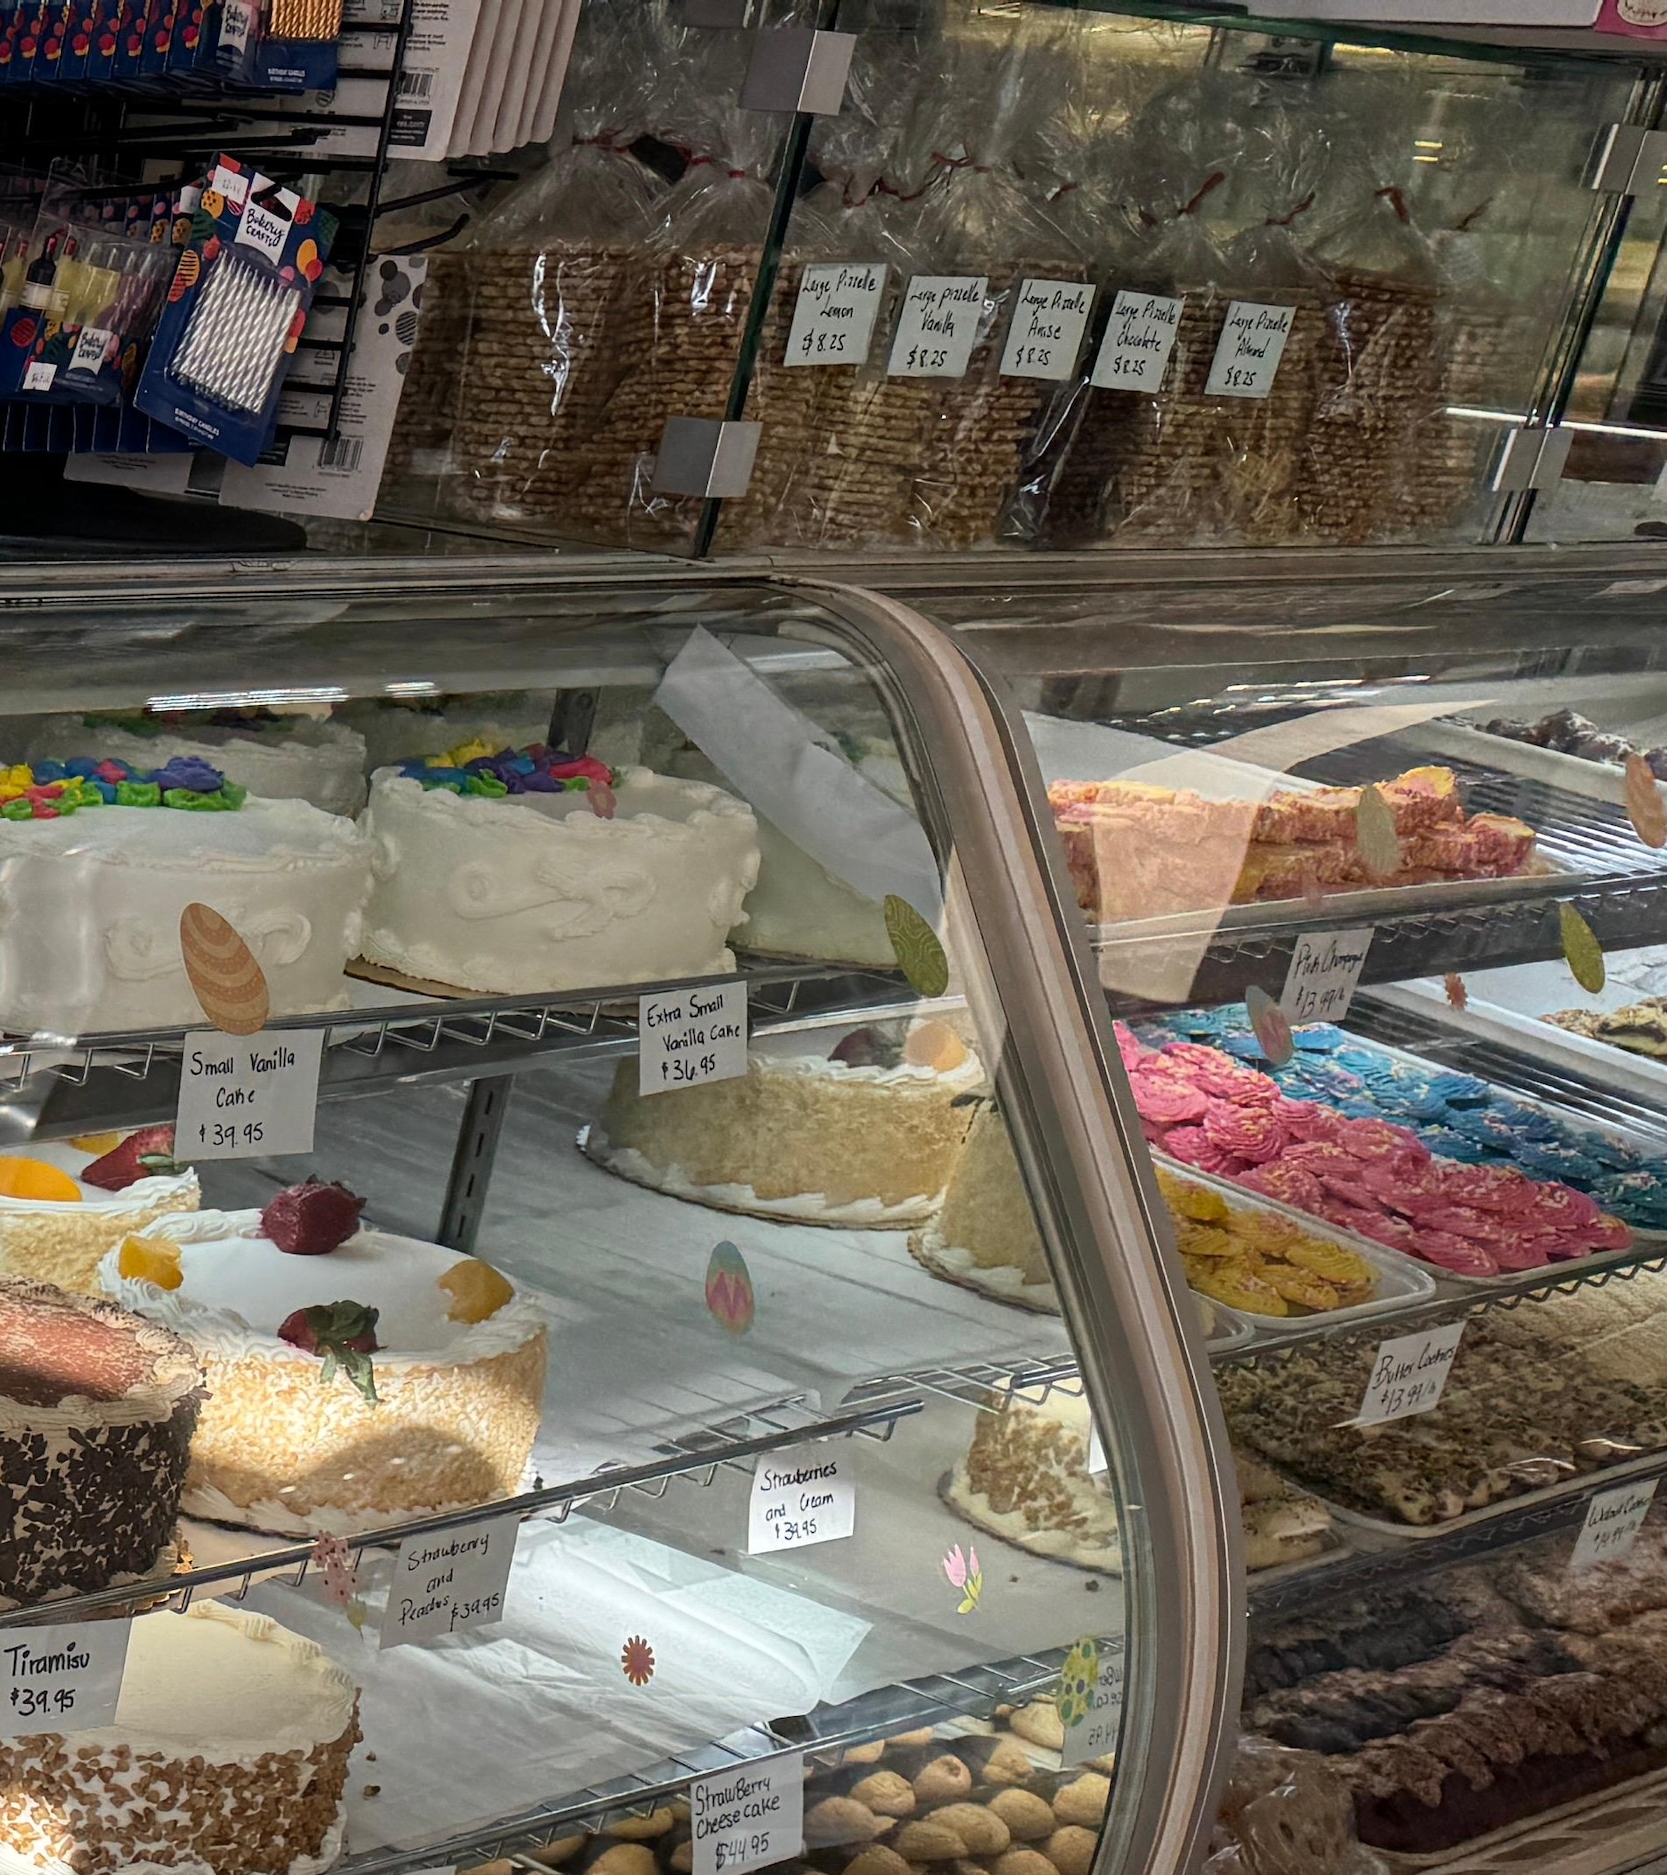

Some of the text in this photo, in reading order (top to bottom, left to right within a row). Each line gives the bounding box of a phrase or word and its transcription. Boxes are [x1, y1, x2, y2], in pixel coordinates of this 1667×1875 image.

[246, 208, 285, 245] Bakery
[802, 268, 830, 300] Large
[820, 295, 854, 319] Lemon
[910, 292, 936, 313] Large
[1021, 282, 1048, 316] Large
[921, 310, 955, 338] Vanilla
[1028, 316, 1061, 340] Anise
[802, 328, 846, 357] $8.25
[907, 344, 947, 370] $8.25
[1016, 345, 1051, 368] $8.25
[1114, 355, 1146, 376] $8.25
[1224, 365, 1257, 387] $8.25
[647, 994, 723, 1028] Extra Small
[662, 1024, 740, 1052] Vanilla Cake
[190, 1046, 295, 1076] Small Vanilla
[216, 1086, 255, 1108] Cake
[1372, 1354, 1415, 1390] Butter
[760, 1461, 838, 1492] Strawberries
[765, 1492, 834, 1522] and Cream
[407, 1533, 490, 1571] Strawberry
[426, 1567, 454, 1593] and
[3, 1641, 90, 1677] Tiramisu
[10, 1686, 76, 1717] $39.95
